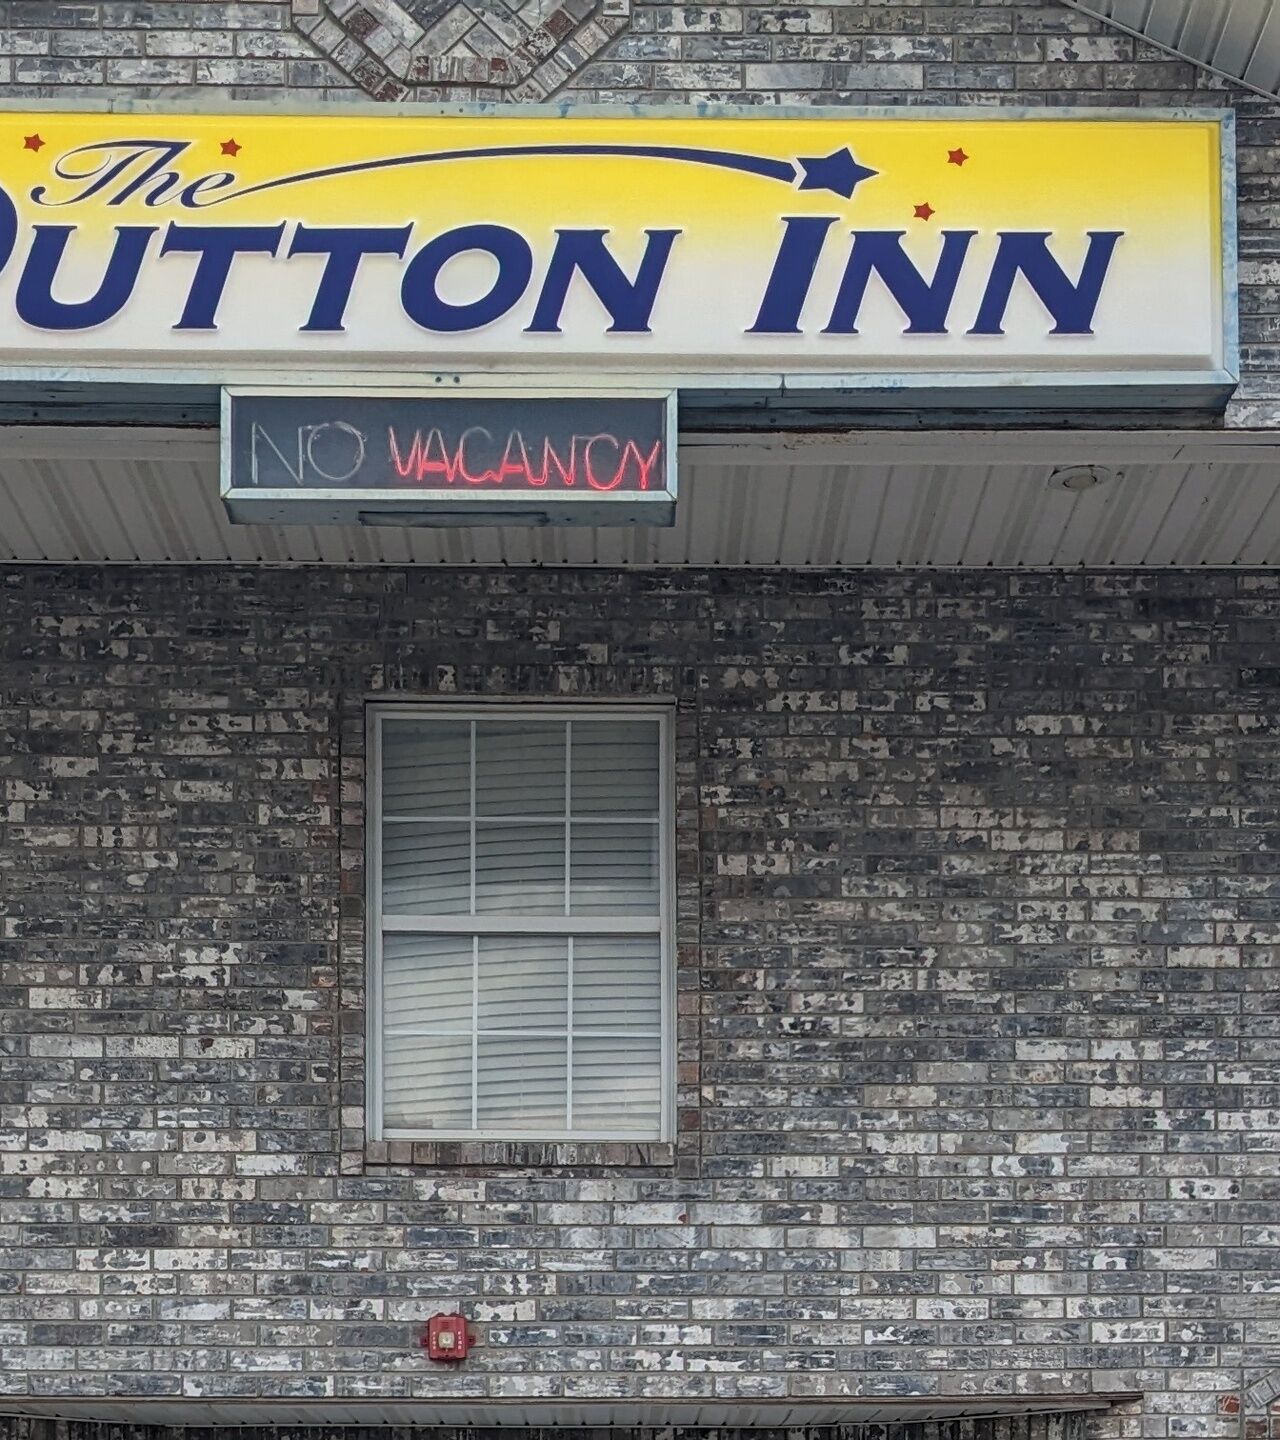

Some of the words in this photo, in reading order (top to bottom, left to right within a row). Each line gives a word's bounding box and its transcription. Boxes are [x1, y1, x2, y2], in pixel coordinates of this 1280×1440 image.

[30, 139, 235, 207] The
[743, 216, 1125, 335] INN
[251, 421, 367, 485] NO
[388, 425, 661, 491] VACANCY
